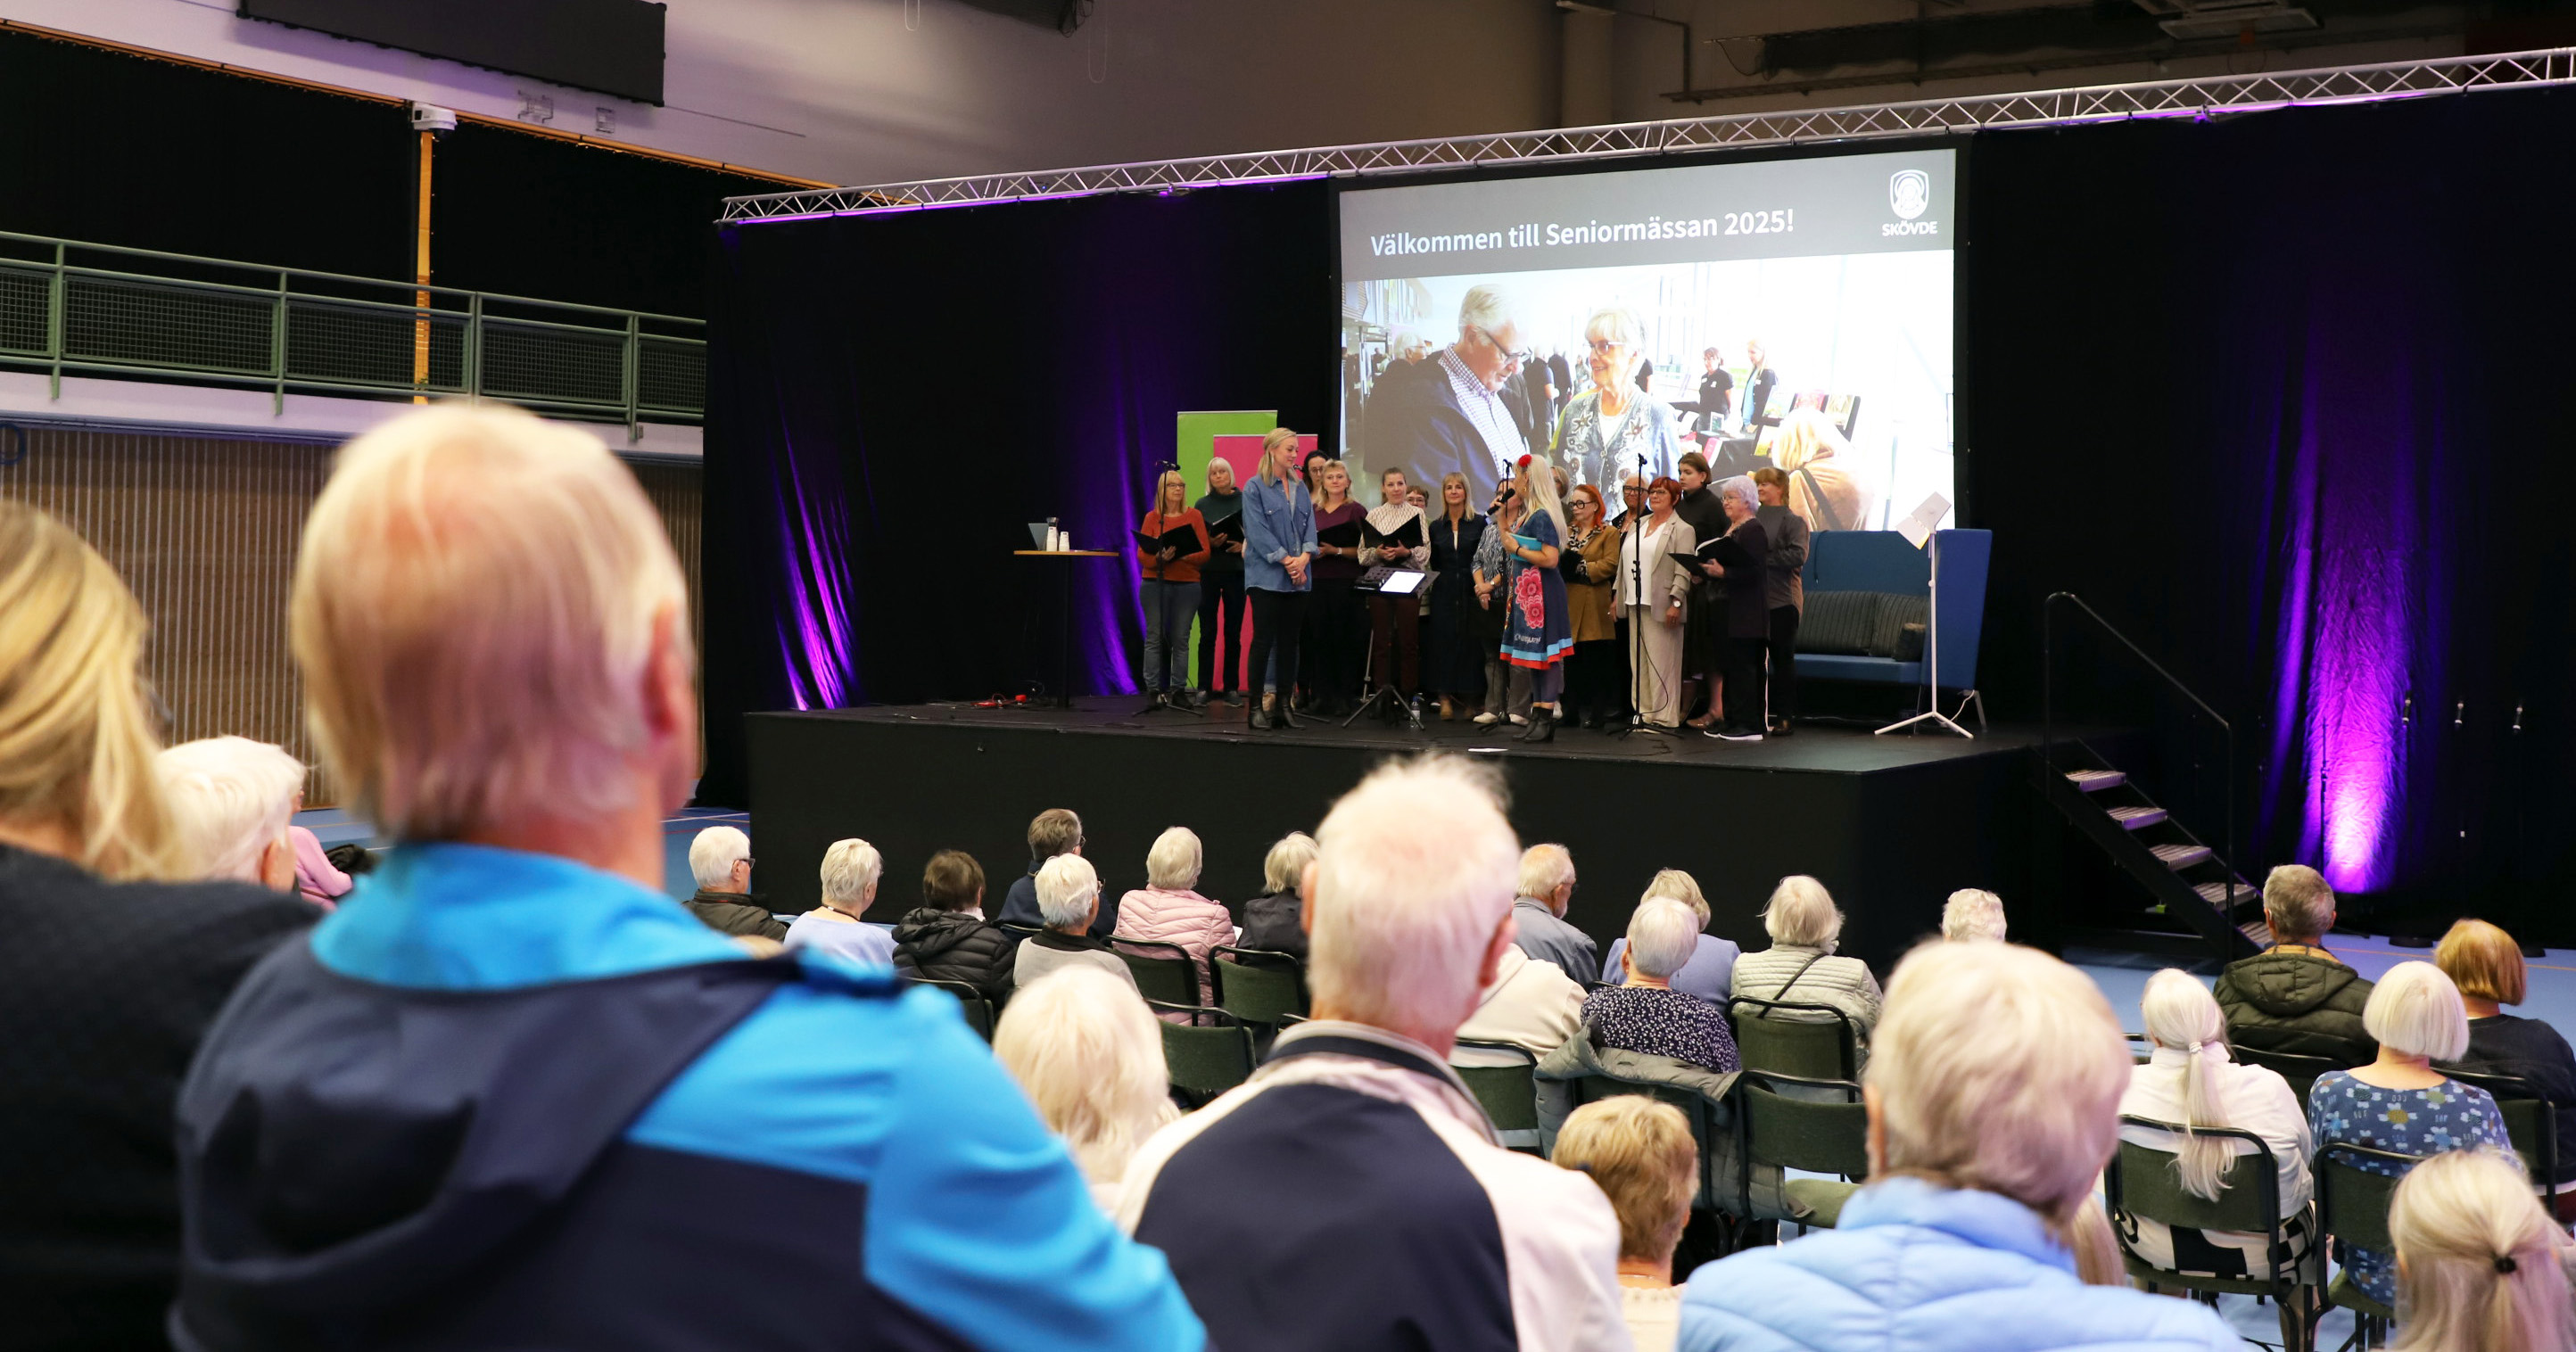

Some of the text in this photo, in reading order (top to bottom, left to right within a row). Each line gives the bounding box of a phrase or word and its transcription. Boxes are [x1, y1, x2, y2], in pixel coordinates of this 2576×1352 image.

[1370, 208, 1795, 256] Välkommen till Seniormässan 2025!
[1881, 219, 1938, 236] SKÖVDE
